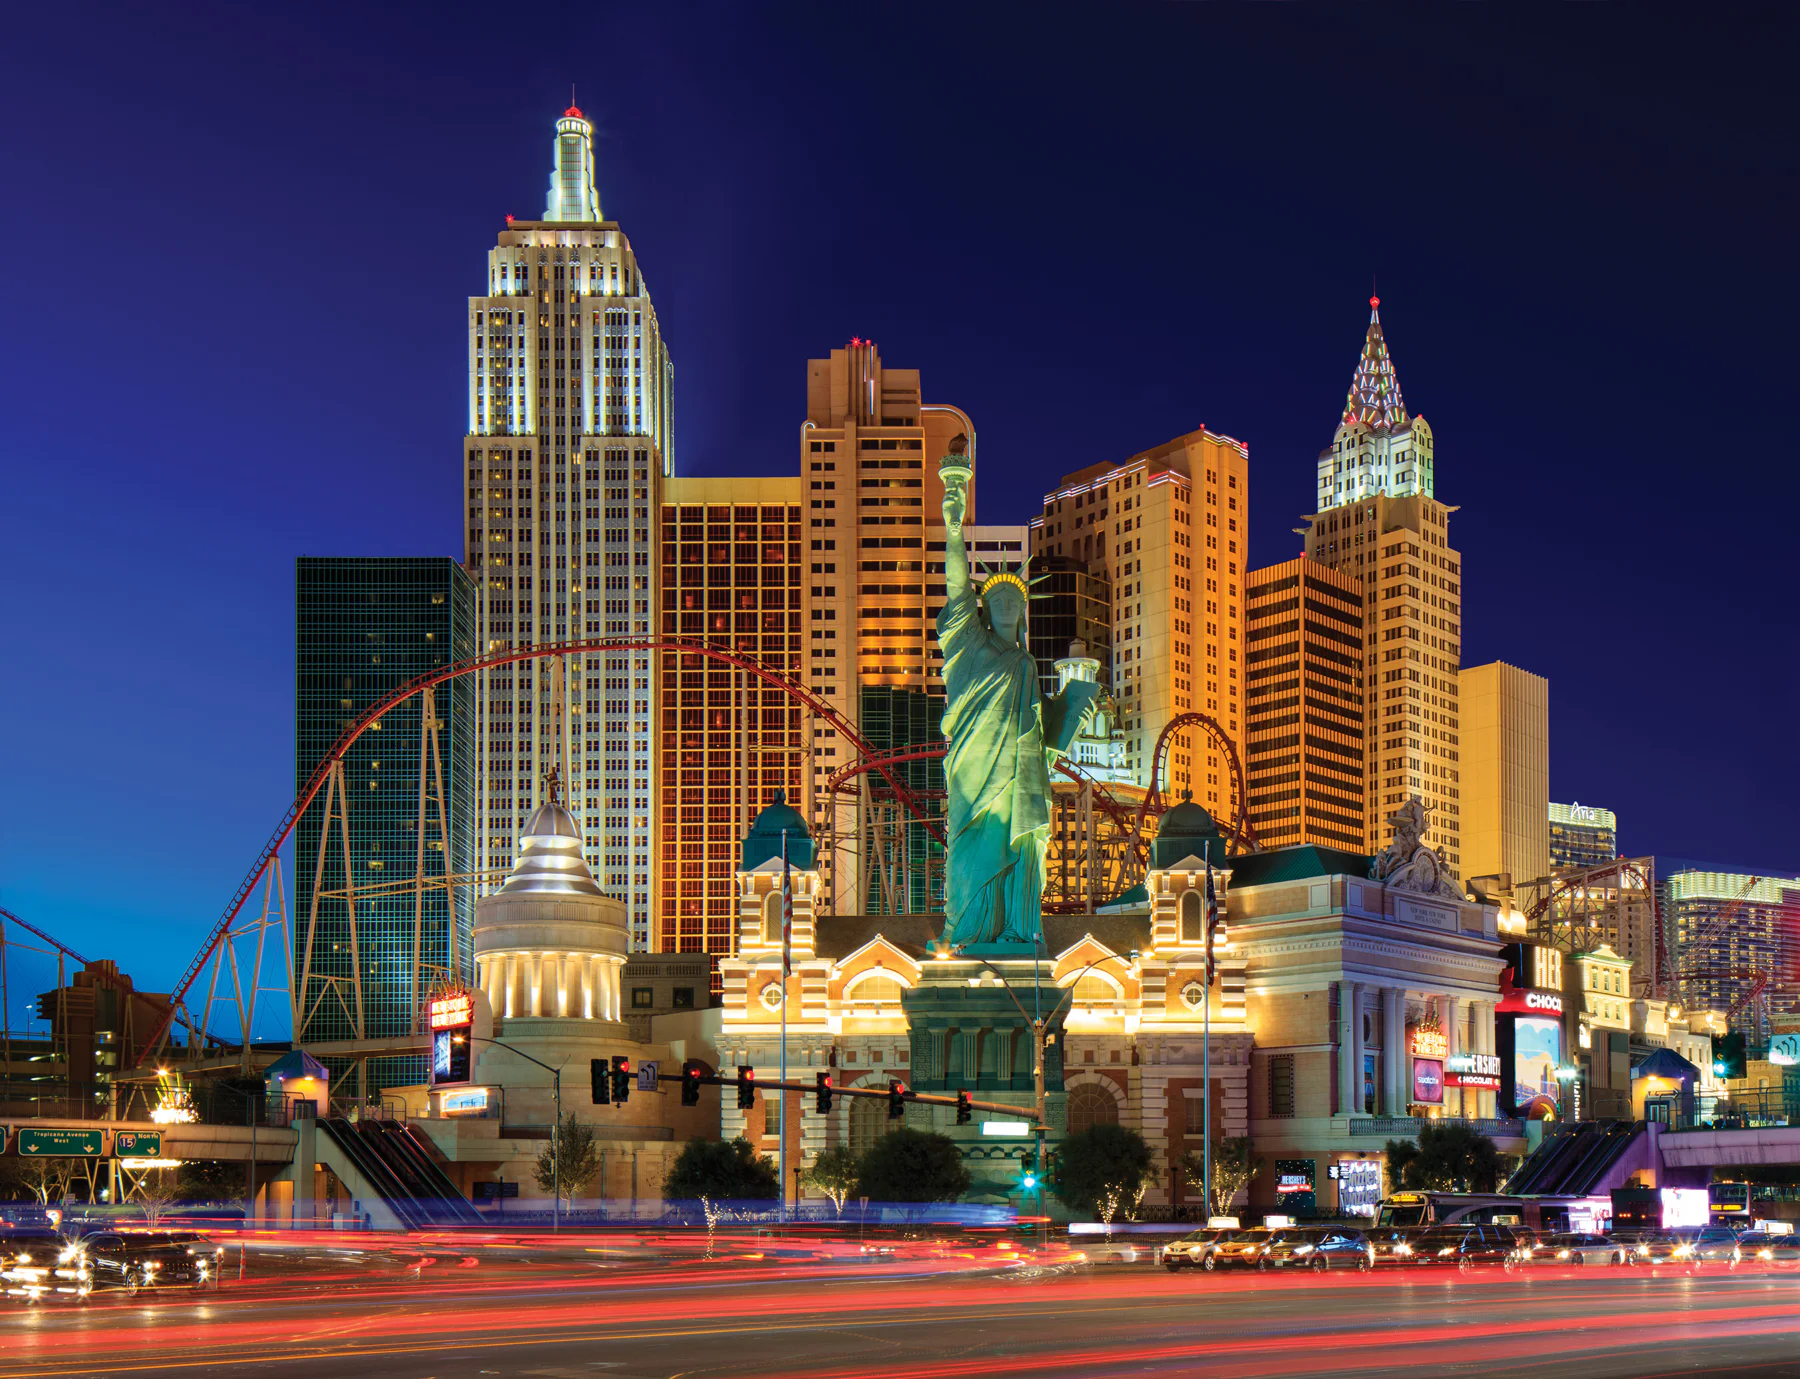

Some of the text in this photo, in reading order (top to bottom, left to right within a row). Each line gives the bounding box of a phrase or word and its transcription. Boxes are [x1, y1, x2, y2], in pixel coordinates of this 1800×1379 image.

[1570, 800, 1595, 821] Aria
[1417, 1076, 1436, 1085] swatch
[122, 1138, 134, 1148] 15
[1281, 1175, 1306, 1185] HERSHEY'S
